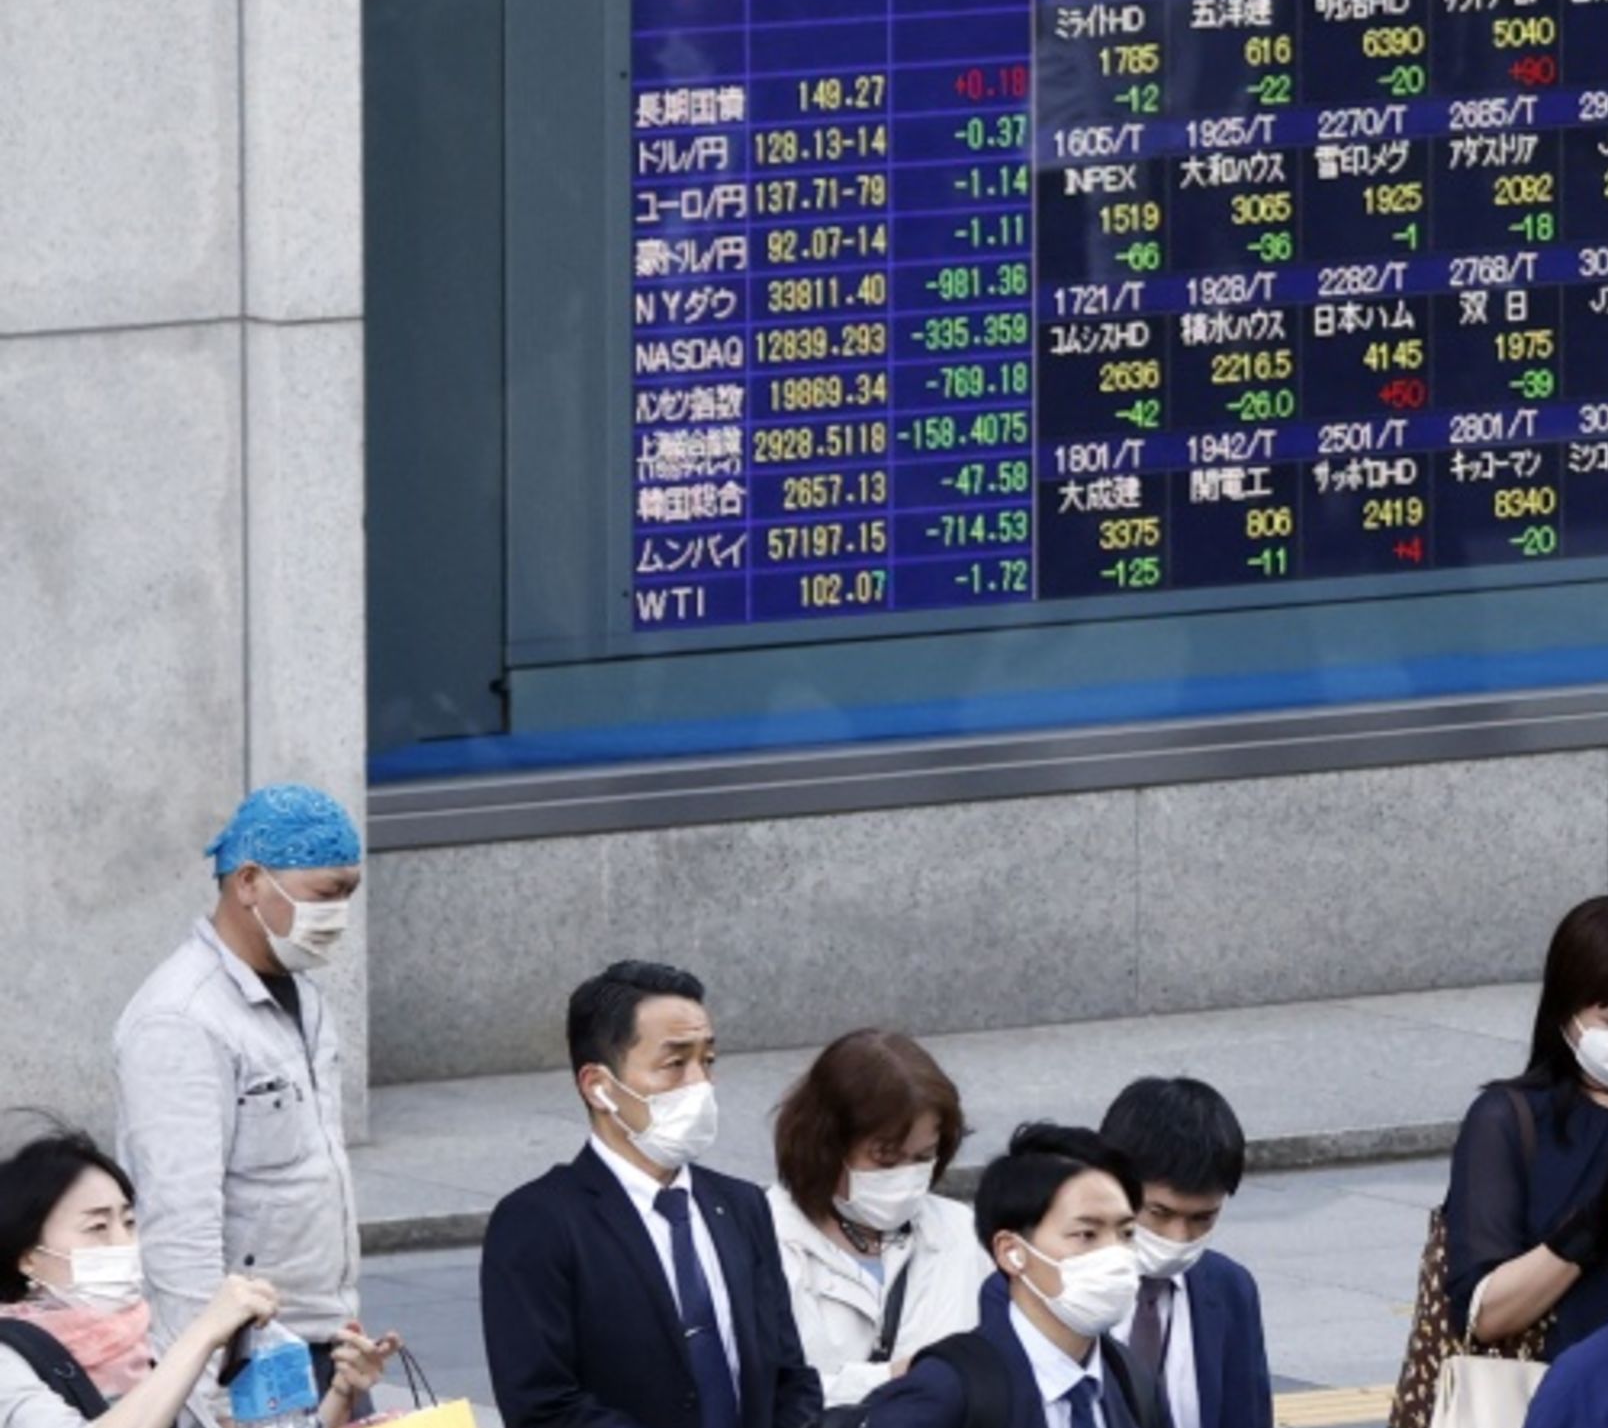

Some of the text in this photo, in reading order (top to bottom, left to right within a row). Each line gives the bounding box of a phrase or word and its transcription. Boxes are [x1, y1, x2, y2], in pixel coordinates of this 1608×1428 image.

[636, 86, 746, 128] 長期国債
[799, 74, 885, 111] 149.27
[1053, 122, 1144, 158] 1605/T
[1185, 113, 1276, 148] 1925/T
[1317, 104, 1408, 140] 2270/T
[639, 113, 1029, 174] ドル/円 128.13-14 -0.37
[635, 164, 1029, 223] ユーロ/円 137.71-79 -1.14
[1064, 164, 1137, 195] INPEX
[767, 224, 885, 263] 92.07-14
[954, 214, 1024, 247] -1.11
[1317, 261, 1408, 297] 2282/T
[1449, 251, 1538, 287] 2768/T
[635, 263, 1028, 324] NYダウ 33811.40 -981.36
[1054, 280, 1145, 315] 1721/T
[1186, 270, 1277, 306] 1928/T
[635, 312, 1028, 373] NASDAQ 12839.293 -335.359
[770, 372, 885, 411] 19869.34
[926, 361, 1028, 398] -769.18
[753, 421, 885, 463] 2928.5118
[897, 411, 1028, 450] -158.4075
[1318, 418, 1408, 454] 2501/T
[1449, 408, 1539, 444] 2801/T
[1055, 438, 1145, 473] 1801/T
[1187, 428, 1277, 463] 1942/T
[783, 470, 885, 510] 2657.13
[941, 460, 1028, 495] -47.58
[1059, 474, 1141, 512] 大成建
[636, 509, 1028, 573] ムンバイ 57197.15 -714.53
[635, 558, 1028, 621] WTI 102.07 -1.72
